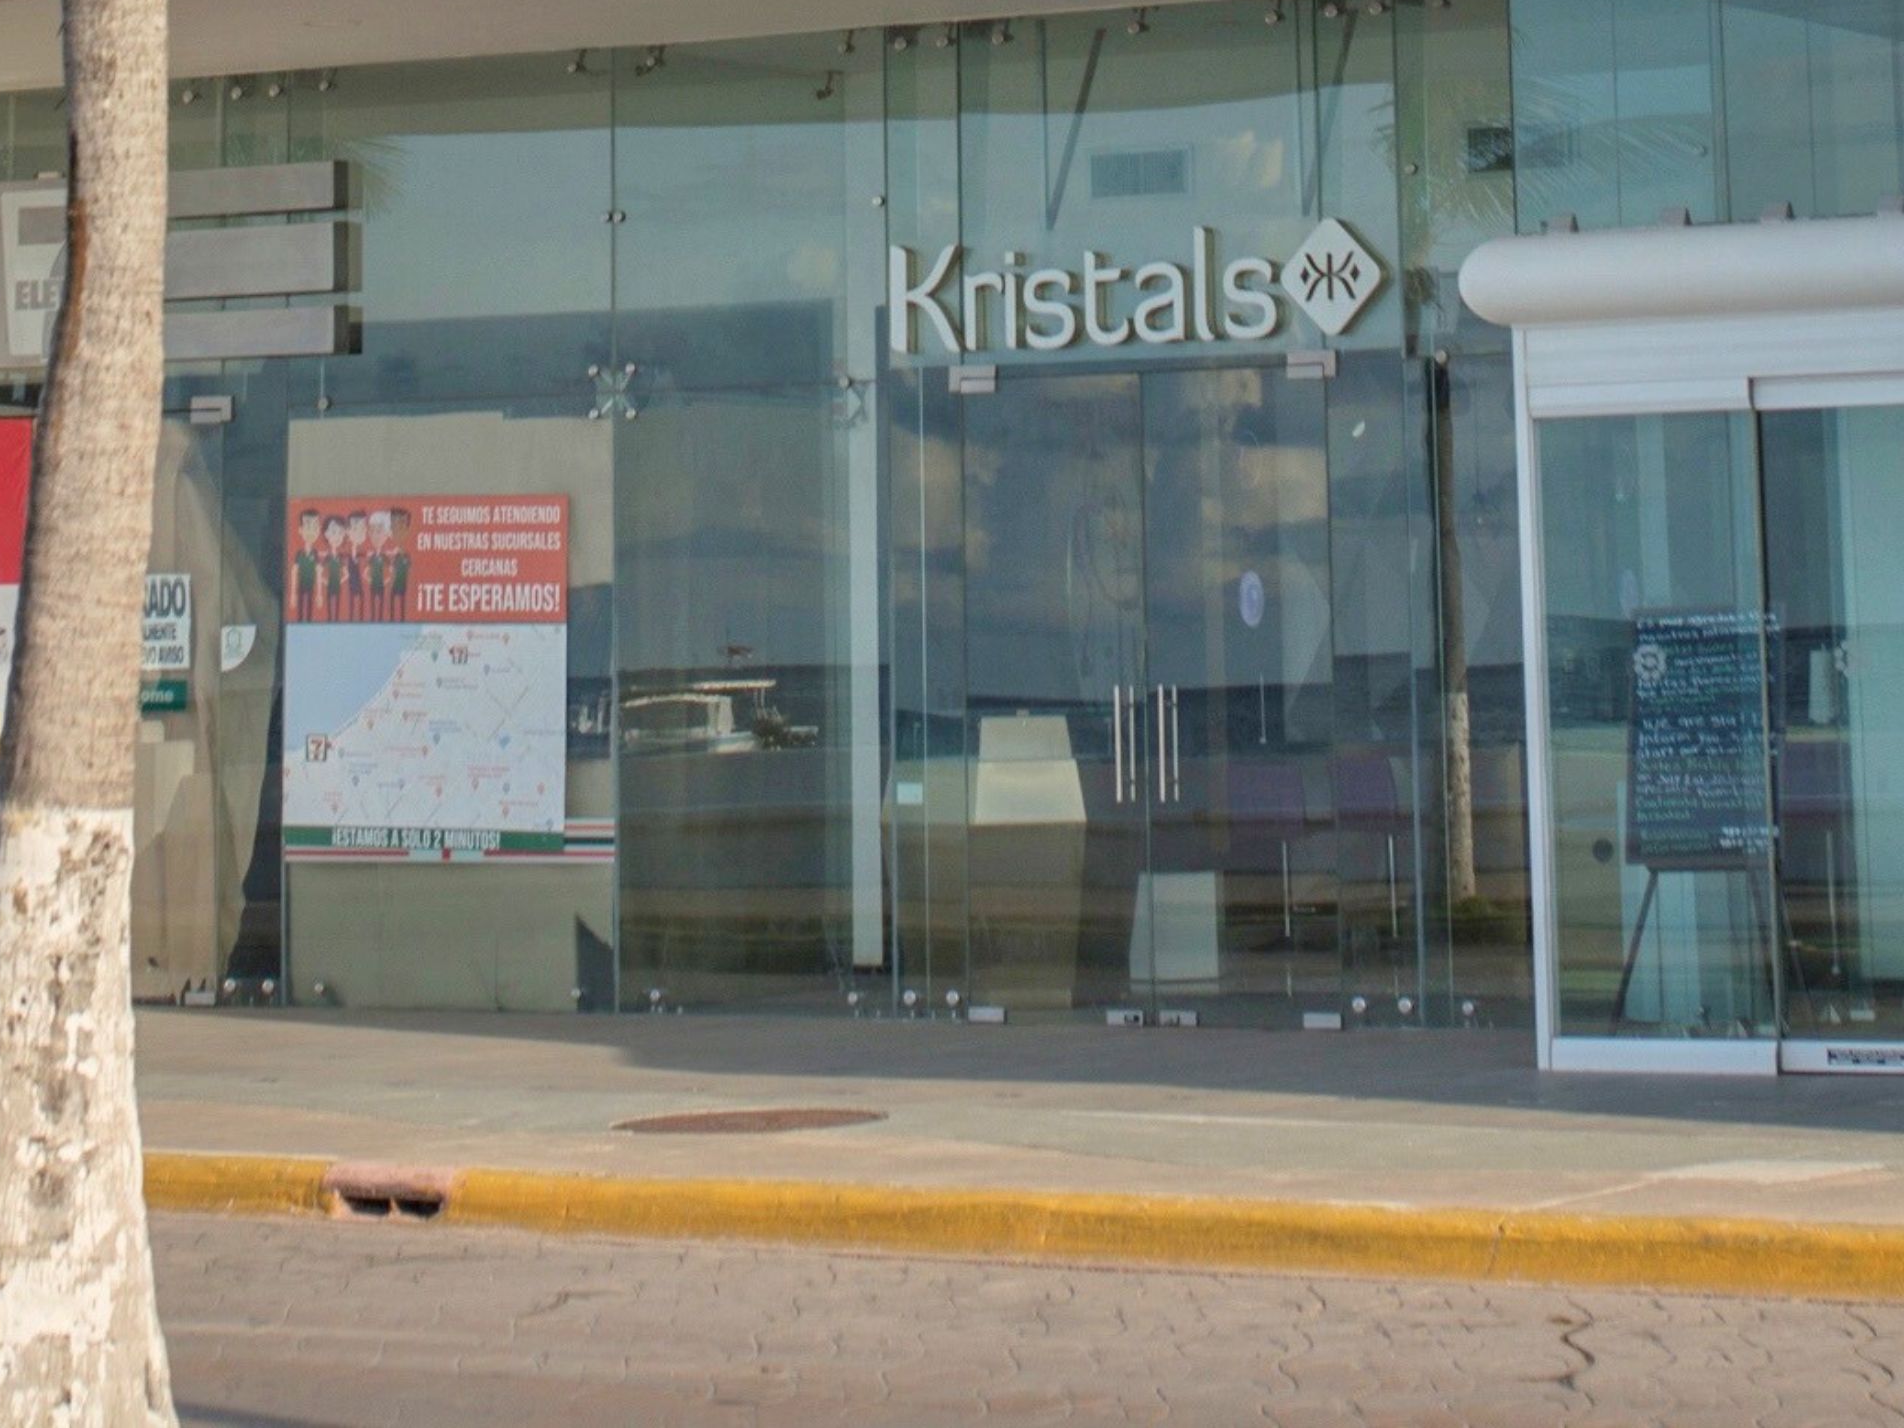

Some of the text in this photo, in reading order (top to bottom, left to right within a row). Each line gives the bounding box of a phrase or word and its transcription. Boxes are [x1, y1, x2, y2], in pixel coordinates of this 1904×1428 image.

[15, 280, 65, 311] ELE
[889, 225, 1281, 354] Kristals
[422, 505, 561, 524] TE SEGUIMOS ATENDIENDO
[417, 532, 561, 551] EN NUESTRAS SUCURSALES
[461, 558, 518, 577] CERCANAS
[145, 578, 186, 618] ADO
[417, 583, 561, 612] ¡TE ESPERAMOS!
[390, 829, 399, 847] A
[433, 830, 442, 848] 2
[443, 829, 502, 850] MINUTOS!
